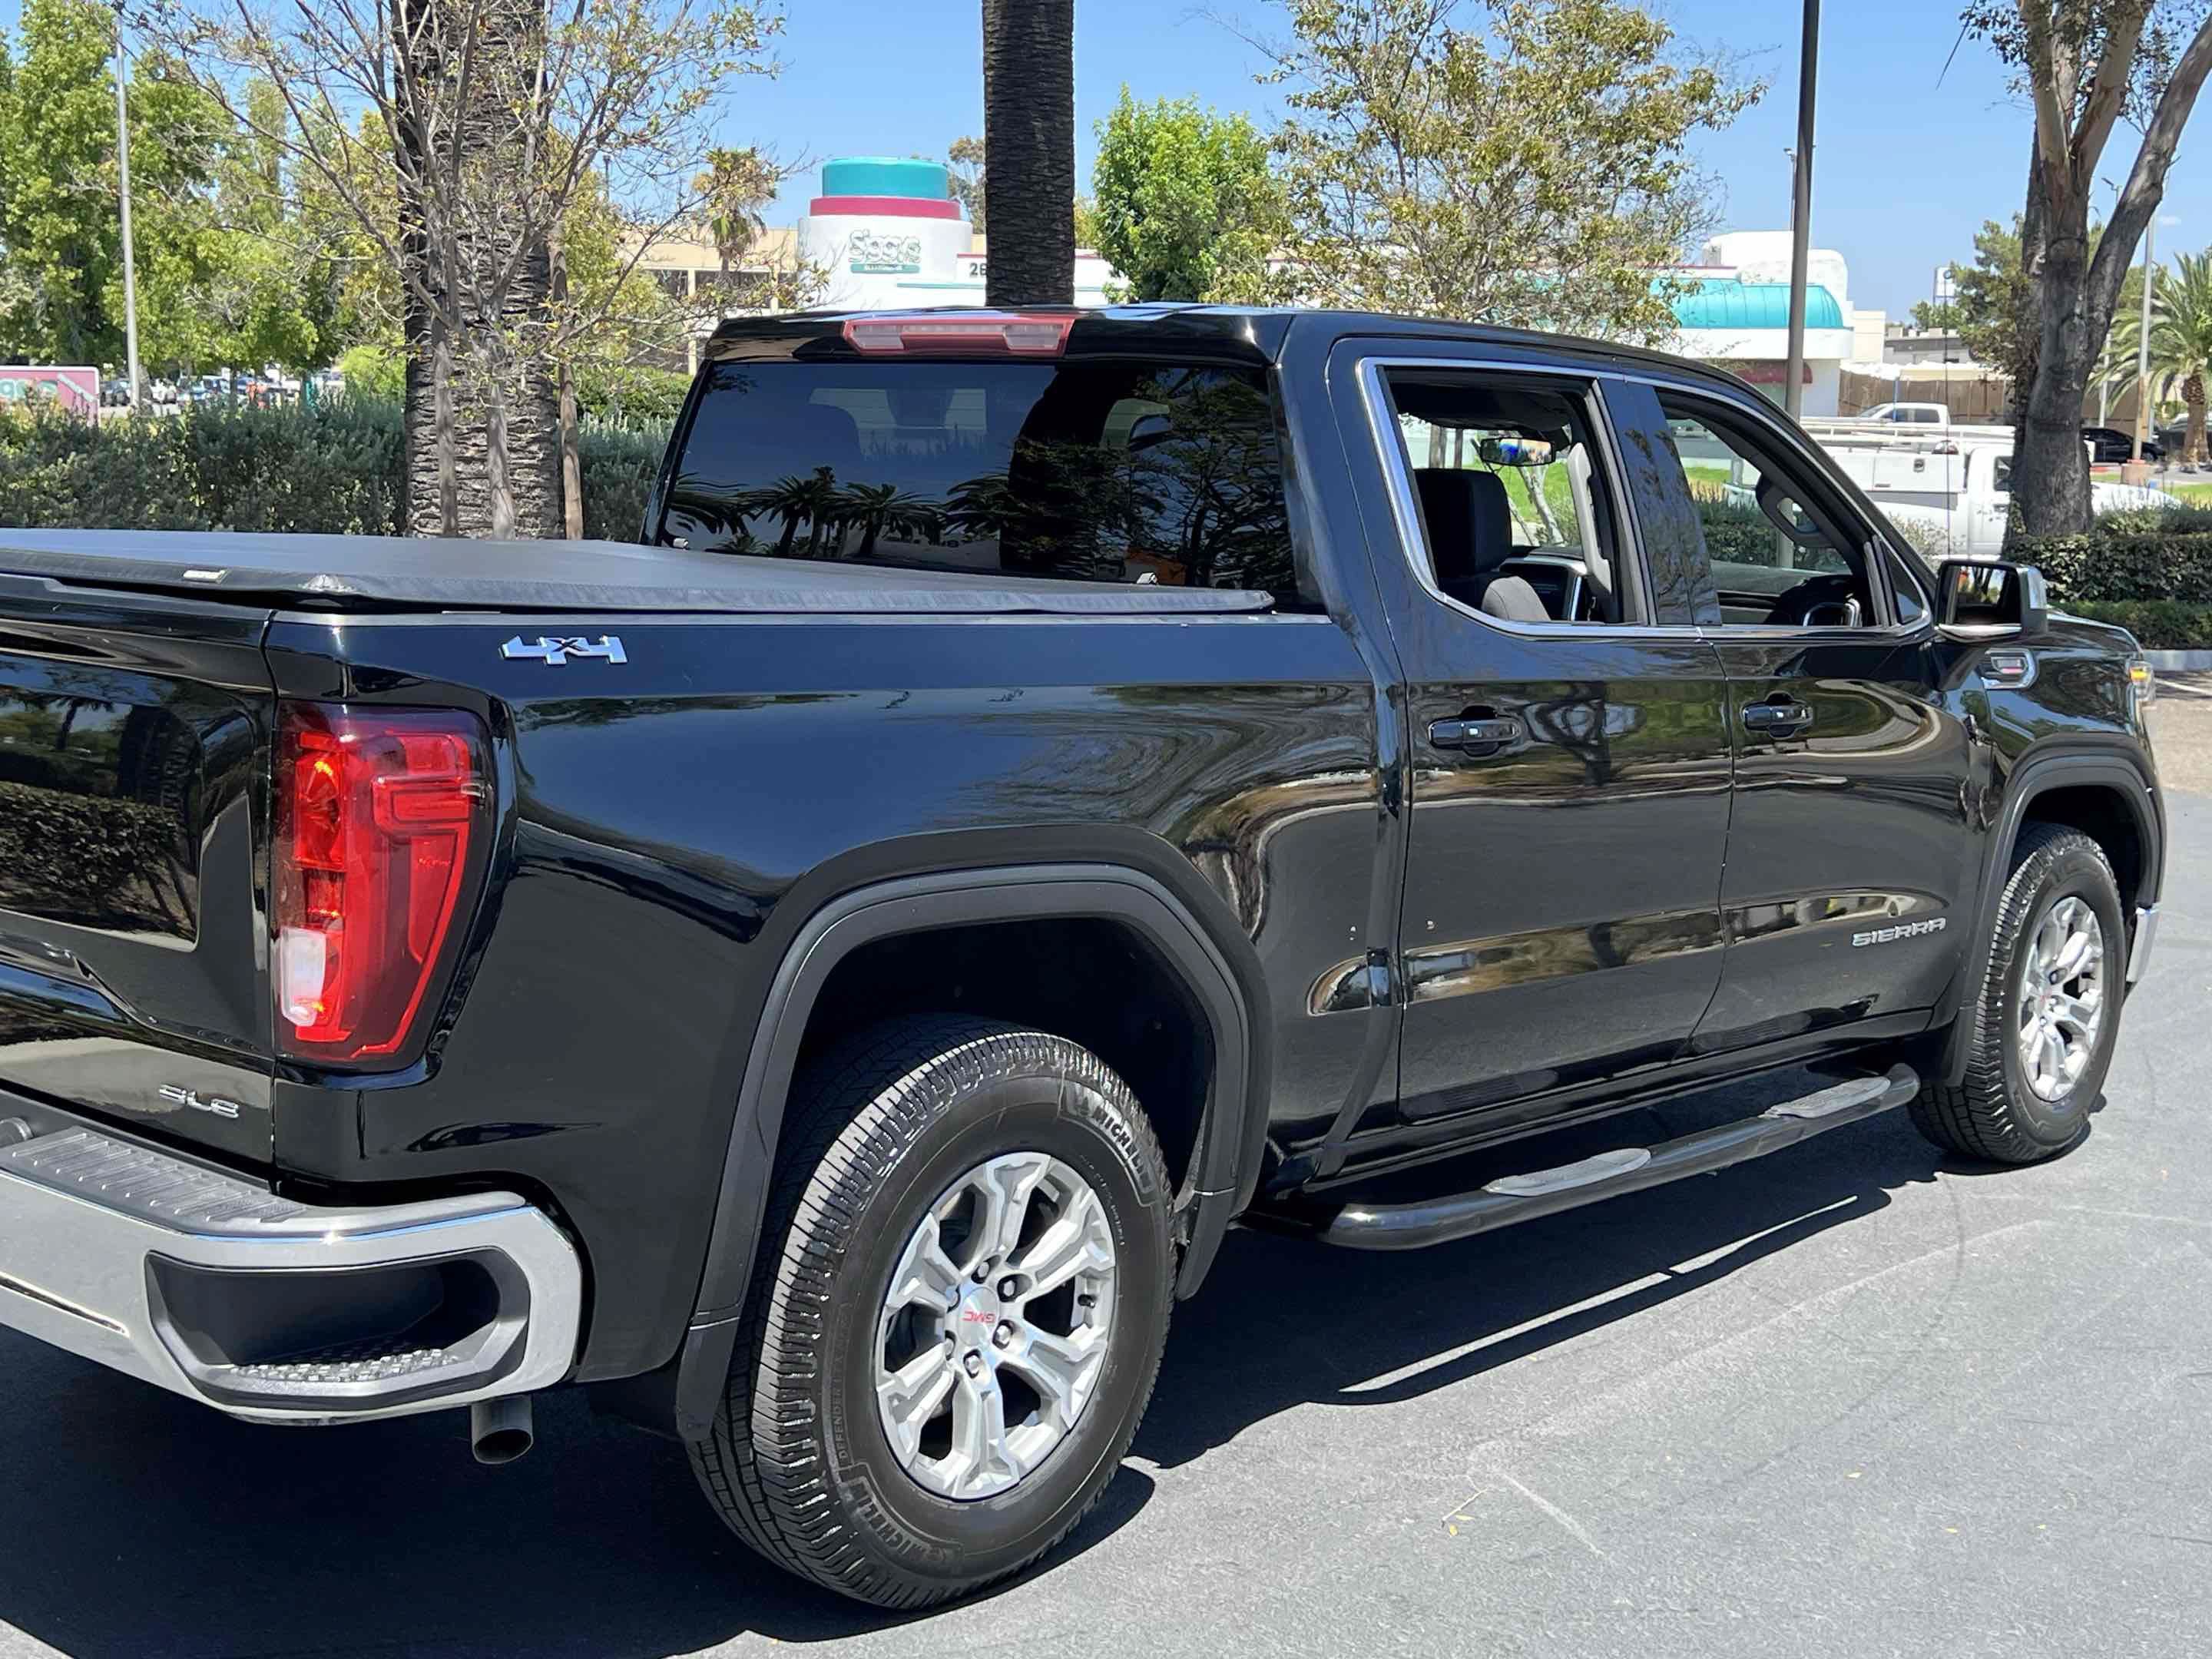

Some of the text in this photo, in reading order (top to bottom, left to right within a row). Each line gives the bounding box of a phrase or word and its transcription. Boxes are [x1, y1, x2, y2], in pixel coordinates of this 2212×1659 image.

[1852, 917, 1946, 946] SIERRA
[159, 1082, 240, 1118] SLE
[963, 1310, 995, 1323] GMC
